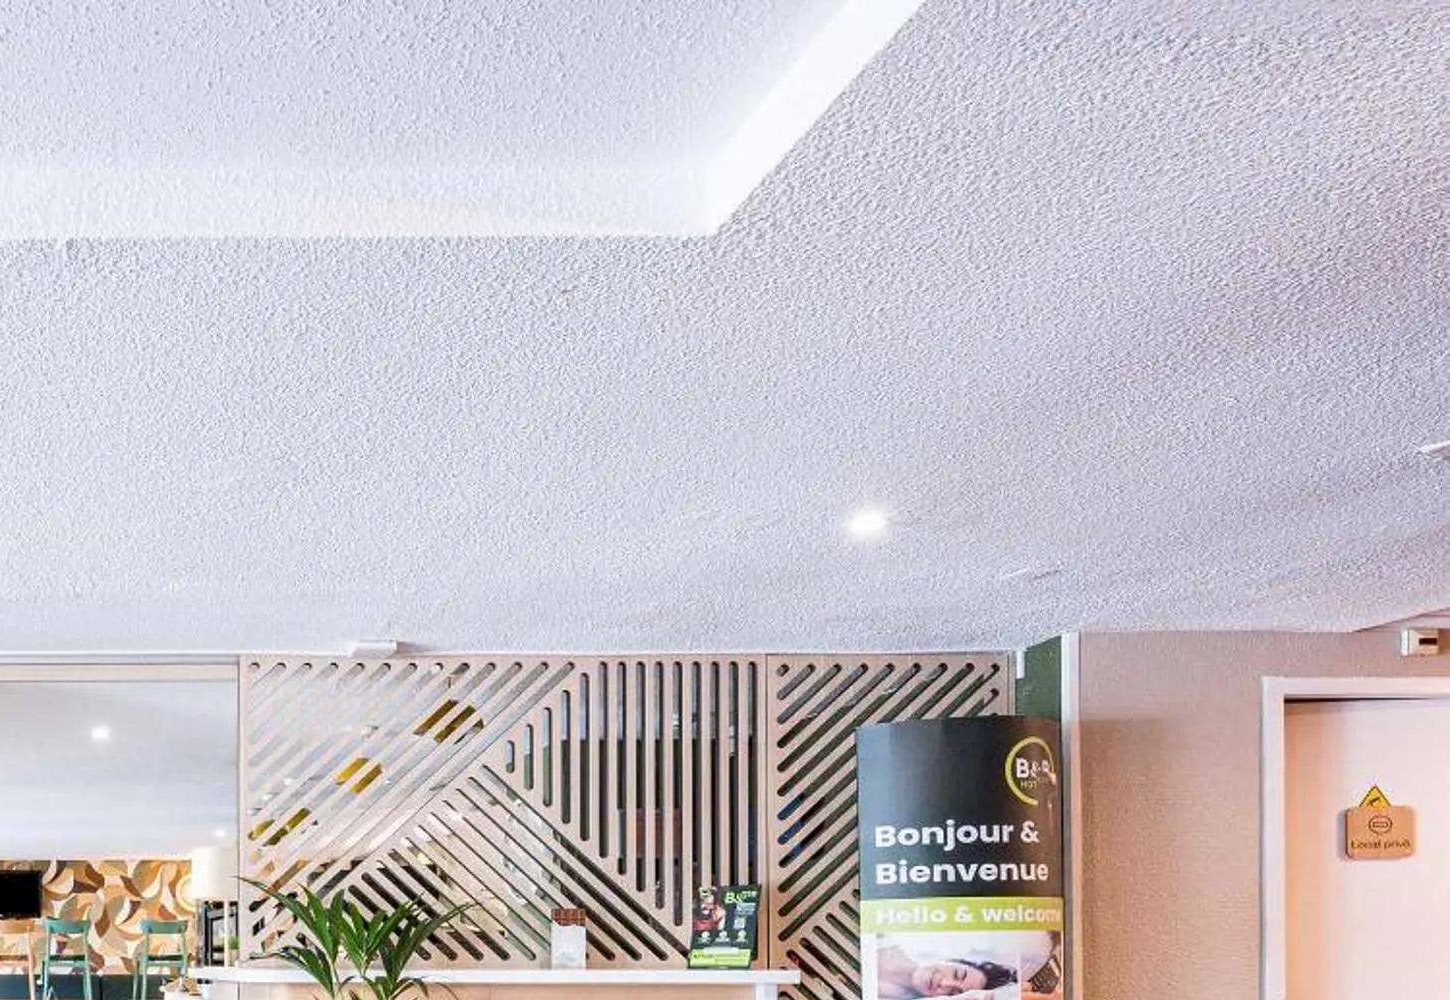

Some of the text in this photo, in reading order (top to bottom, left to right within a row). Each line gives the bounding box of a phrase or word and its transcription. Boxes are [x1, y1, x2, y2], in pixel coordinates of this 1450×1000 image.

[874, 820, 1040, 851] Bonjour &
[875, 859, 1049, 885] Bienvenue
[877, 905, 947, 924] Hello
[954, 905, 974, 923] &
